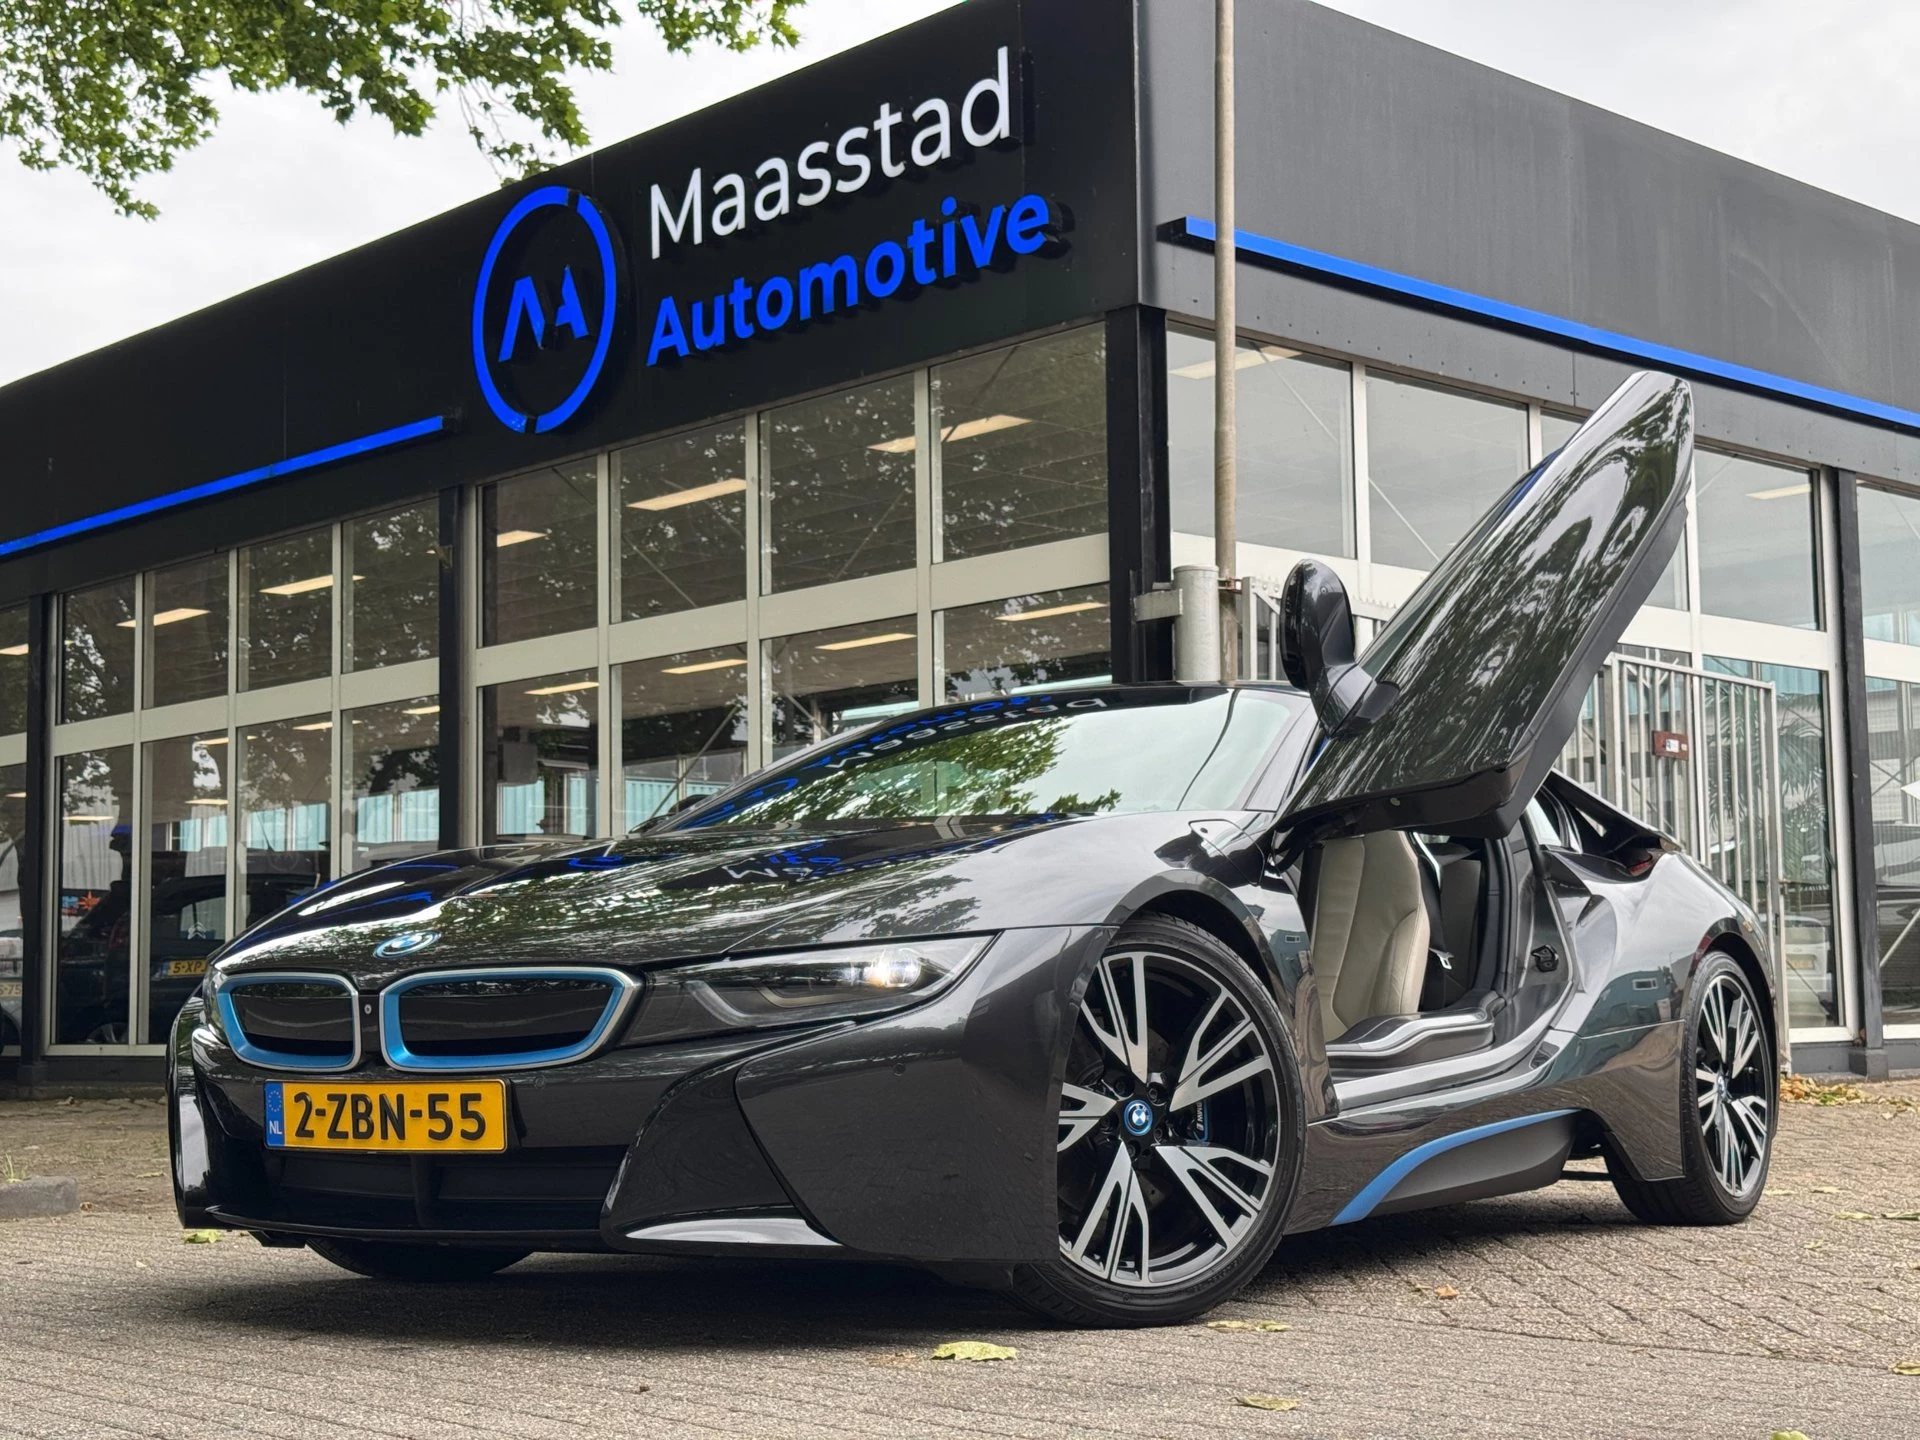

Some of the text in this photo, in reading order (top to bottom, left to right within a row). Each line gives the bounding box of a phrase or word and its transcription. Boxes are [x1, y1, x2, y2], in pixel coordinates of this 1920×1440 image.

[650, 46, 1011, 259] Maasstad
[646, 194, 1051, 366] Automotive
[269, 1119, 283, 1135] NL
[293, 1091, 486, 1141] 2-ZBN-55
